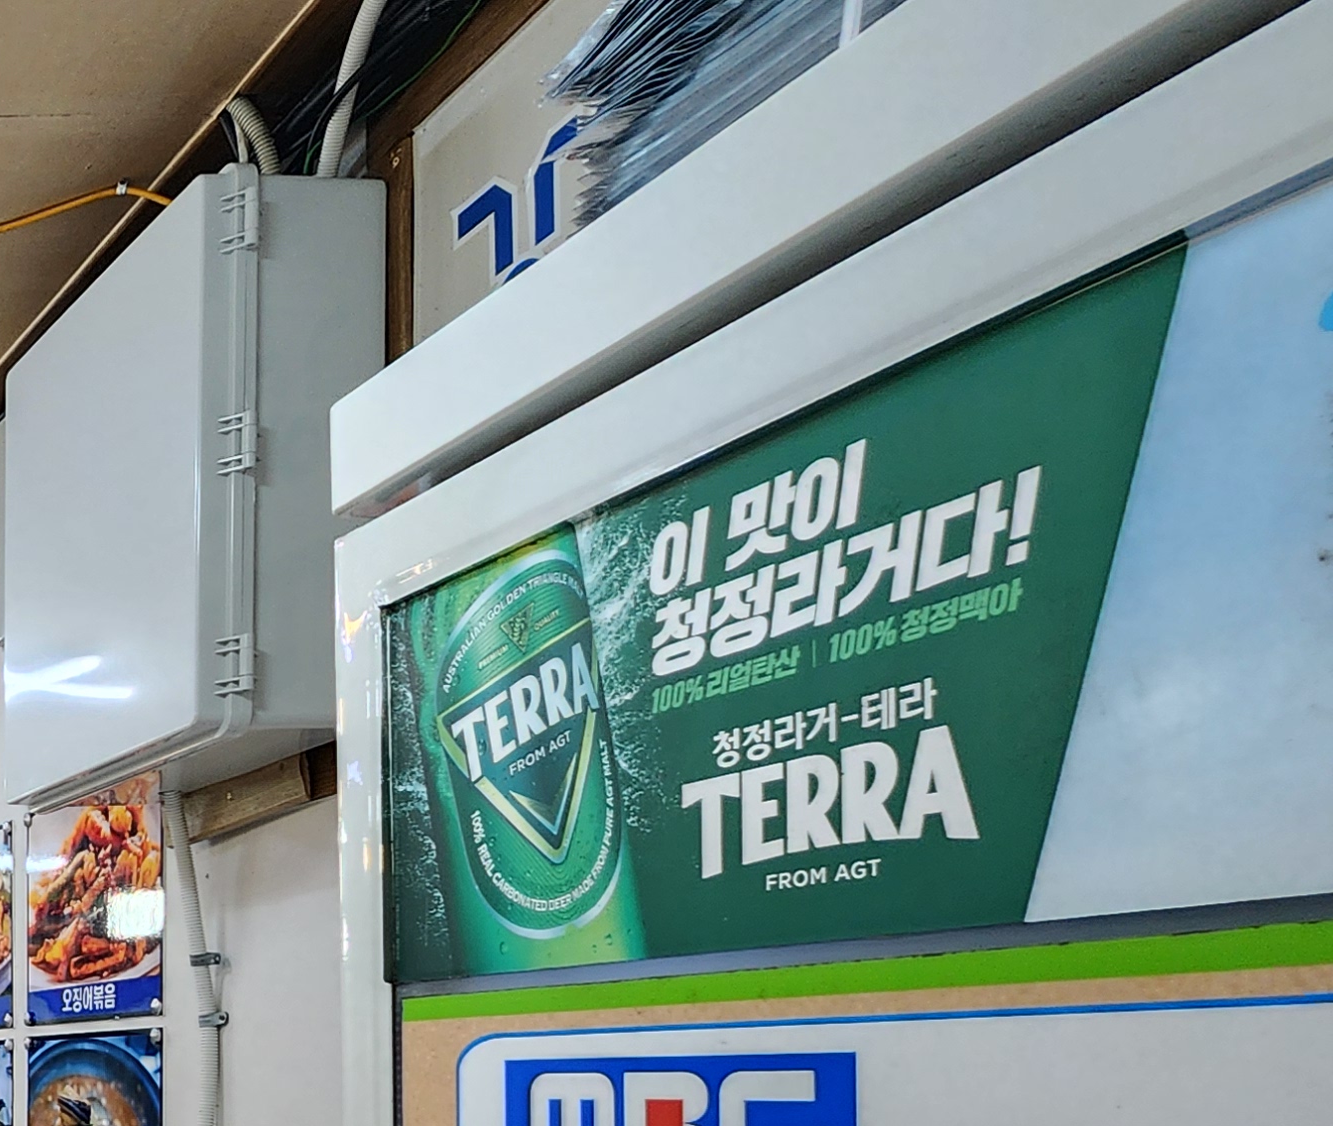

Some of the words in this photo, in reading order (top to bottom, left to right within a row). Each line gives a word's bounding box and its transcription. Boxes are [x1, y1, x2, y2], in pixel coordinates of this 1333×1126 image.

[649, 506, 710, 595] 이
[726, 439, 866, 571] 맛이
[652, 466, 1041, 676] 청정라거다!
[443, 622, 487, 693] AUSTRALIAN
[487, 587, 526, 621] GOLDEN
[525, 571, 568, 593] TRIANGLE
[451, 642, 599, 782] TERRA
[508, 747, 546, 776] FROM
[549, 730, 571, 753] AGT
[599, 739, 612, 777] MALT
[680, 725, 980, 879] TERRA
[470, 810, 485, 842] 100%
[603, 808, 614, 846] PURE
[477, 844, 493, 877] REAL
[765, 866, 829, 891] FROM
[834, 857, 882, 882] AGT
[492, 872, 547, 911] CARBONATED
[62, 983, 116, 1013] 오징어볶음
